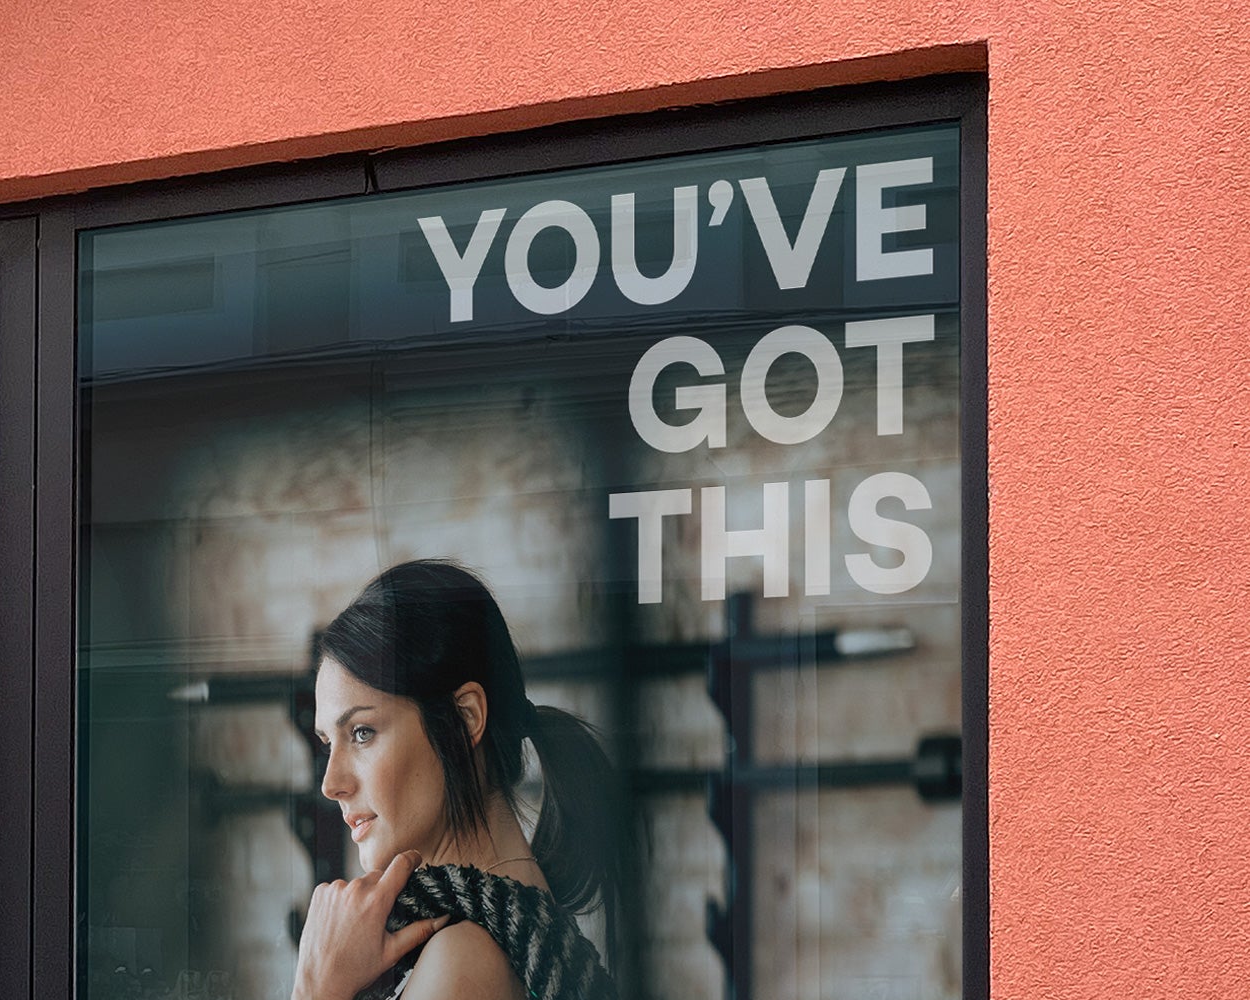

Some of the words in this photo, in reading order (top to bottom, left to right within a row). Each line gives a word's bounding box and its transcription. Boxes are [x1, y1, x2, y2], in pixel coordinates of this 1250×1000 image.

[417, 157, 933, 323] YOU'VE
[629, 314, 935, 453] GOT
[609, 471, 933, 604] THIS
